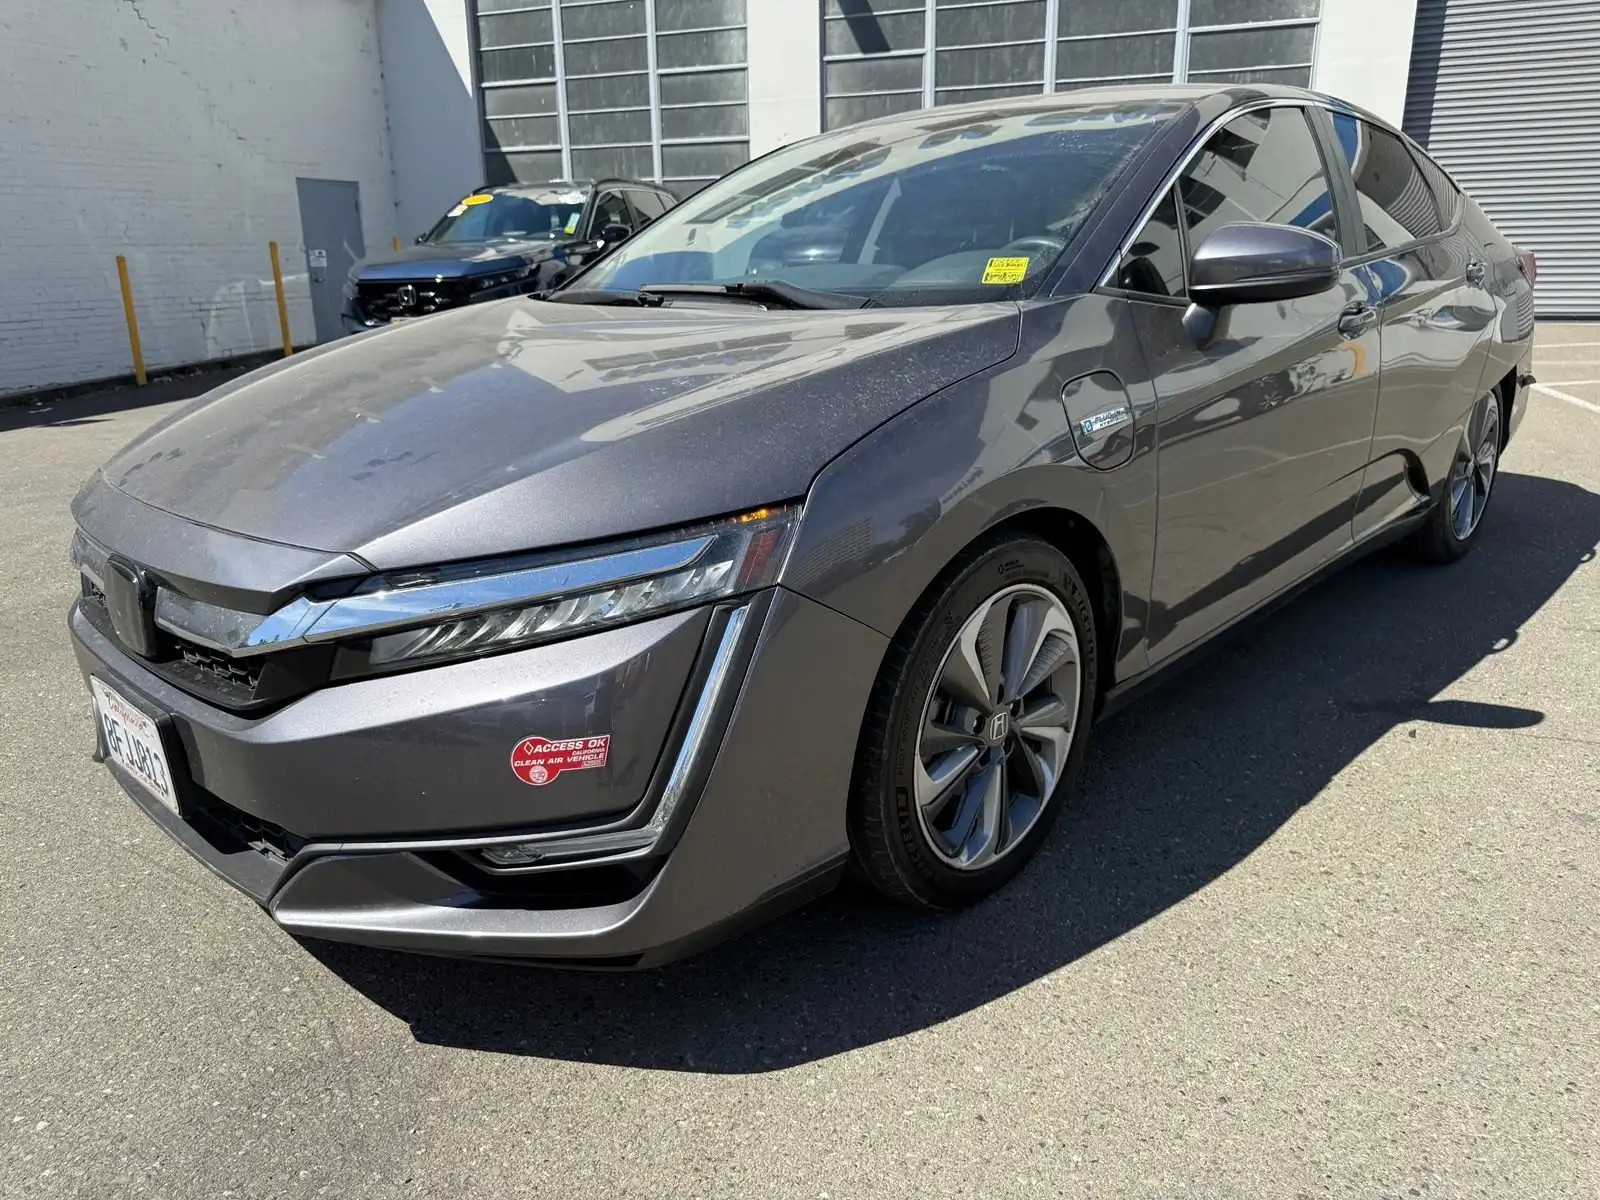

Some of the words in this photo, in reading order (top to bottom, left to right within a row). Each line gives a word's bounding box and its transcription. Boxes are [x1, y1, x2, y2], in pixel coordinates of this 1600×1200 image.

[533, 742, 584, 753] ACCESS
[588, 739, 606, 748] OK
[572, 748, 605, 756] CALIFORNIA
[103, 712, 169, 796] 8FJJ813
[514, 759, 545, 767] CLEAN
[567, 753, 605, 762] VEHICLE
